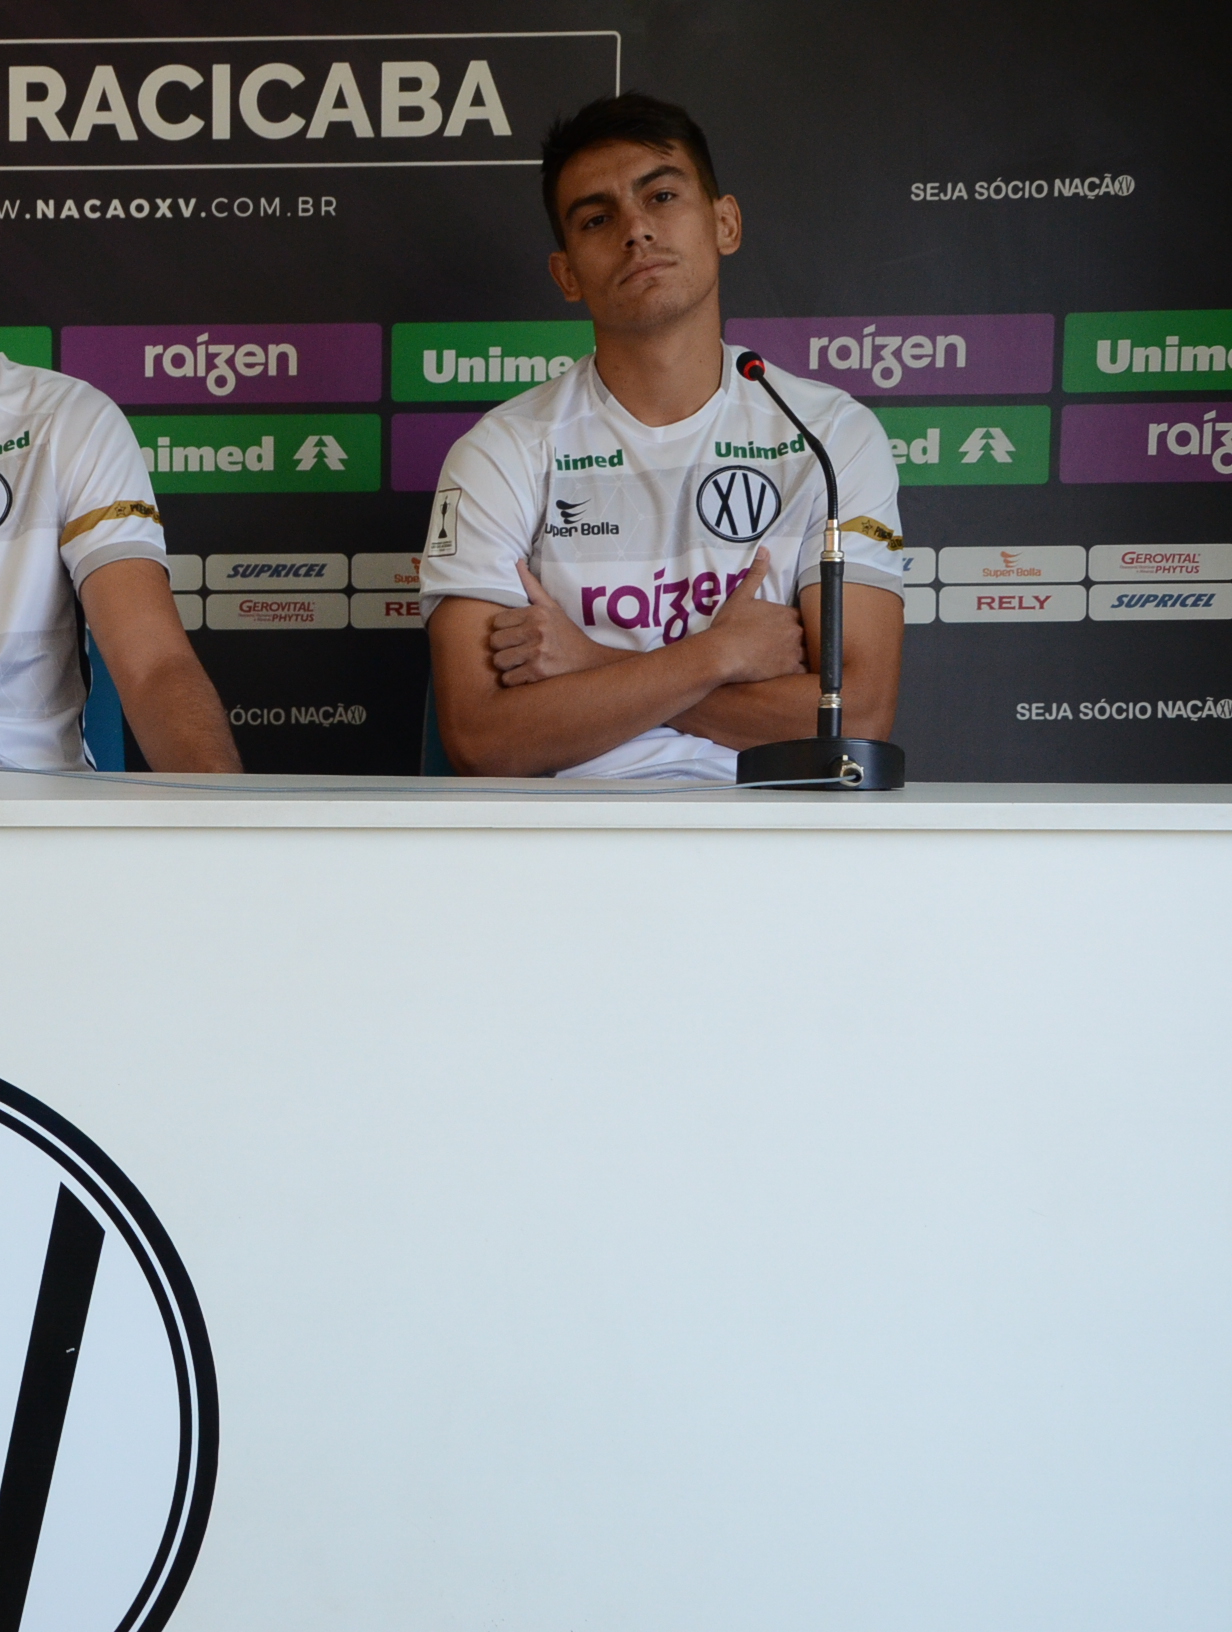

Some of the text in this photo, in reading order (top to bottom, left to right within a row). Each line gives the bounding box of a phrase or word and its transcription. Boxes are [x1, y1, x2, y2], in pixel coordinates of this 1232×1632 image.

[910, 182, 968, 201] SEJA
[974, 177, 1048, 200] SÓCIO
[808, 325, 968, 389] raízen
[1096, 336, 1232, 374] Unim
[144, 333, 297, 396] raízen
[423, 346, 596, 384] Unime
[714, 434, 806, 460] Unimed
[554, 448, 624, 472] nimed
[711, 472, 767, 536] XV
[544, 521, 620, 538] uper Bolla
[1121, 551, 1201, 565] GEROVITAL
[226, 563, 328, 579] SUPRICEL
[982, 567, 1042, 578] Super Bolla
[1154, 565, 1200, 574] PHYTUS
[394, 573, 420, 585] Supe
[239, 600, 315, 613] GEROVITAL
[385, 601, 421, 617] RE
[976, 595, 1052, 611] RELY
[1110, 593, 1217, 609] SUPRICEL
[271, 614, 315, 623] PHYTUS
[226, 704, 286, 726] ÓCIO
[1016, 702, 1074, 720] SEJA
[1078, 698, 1152, 720] SÓCIO
